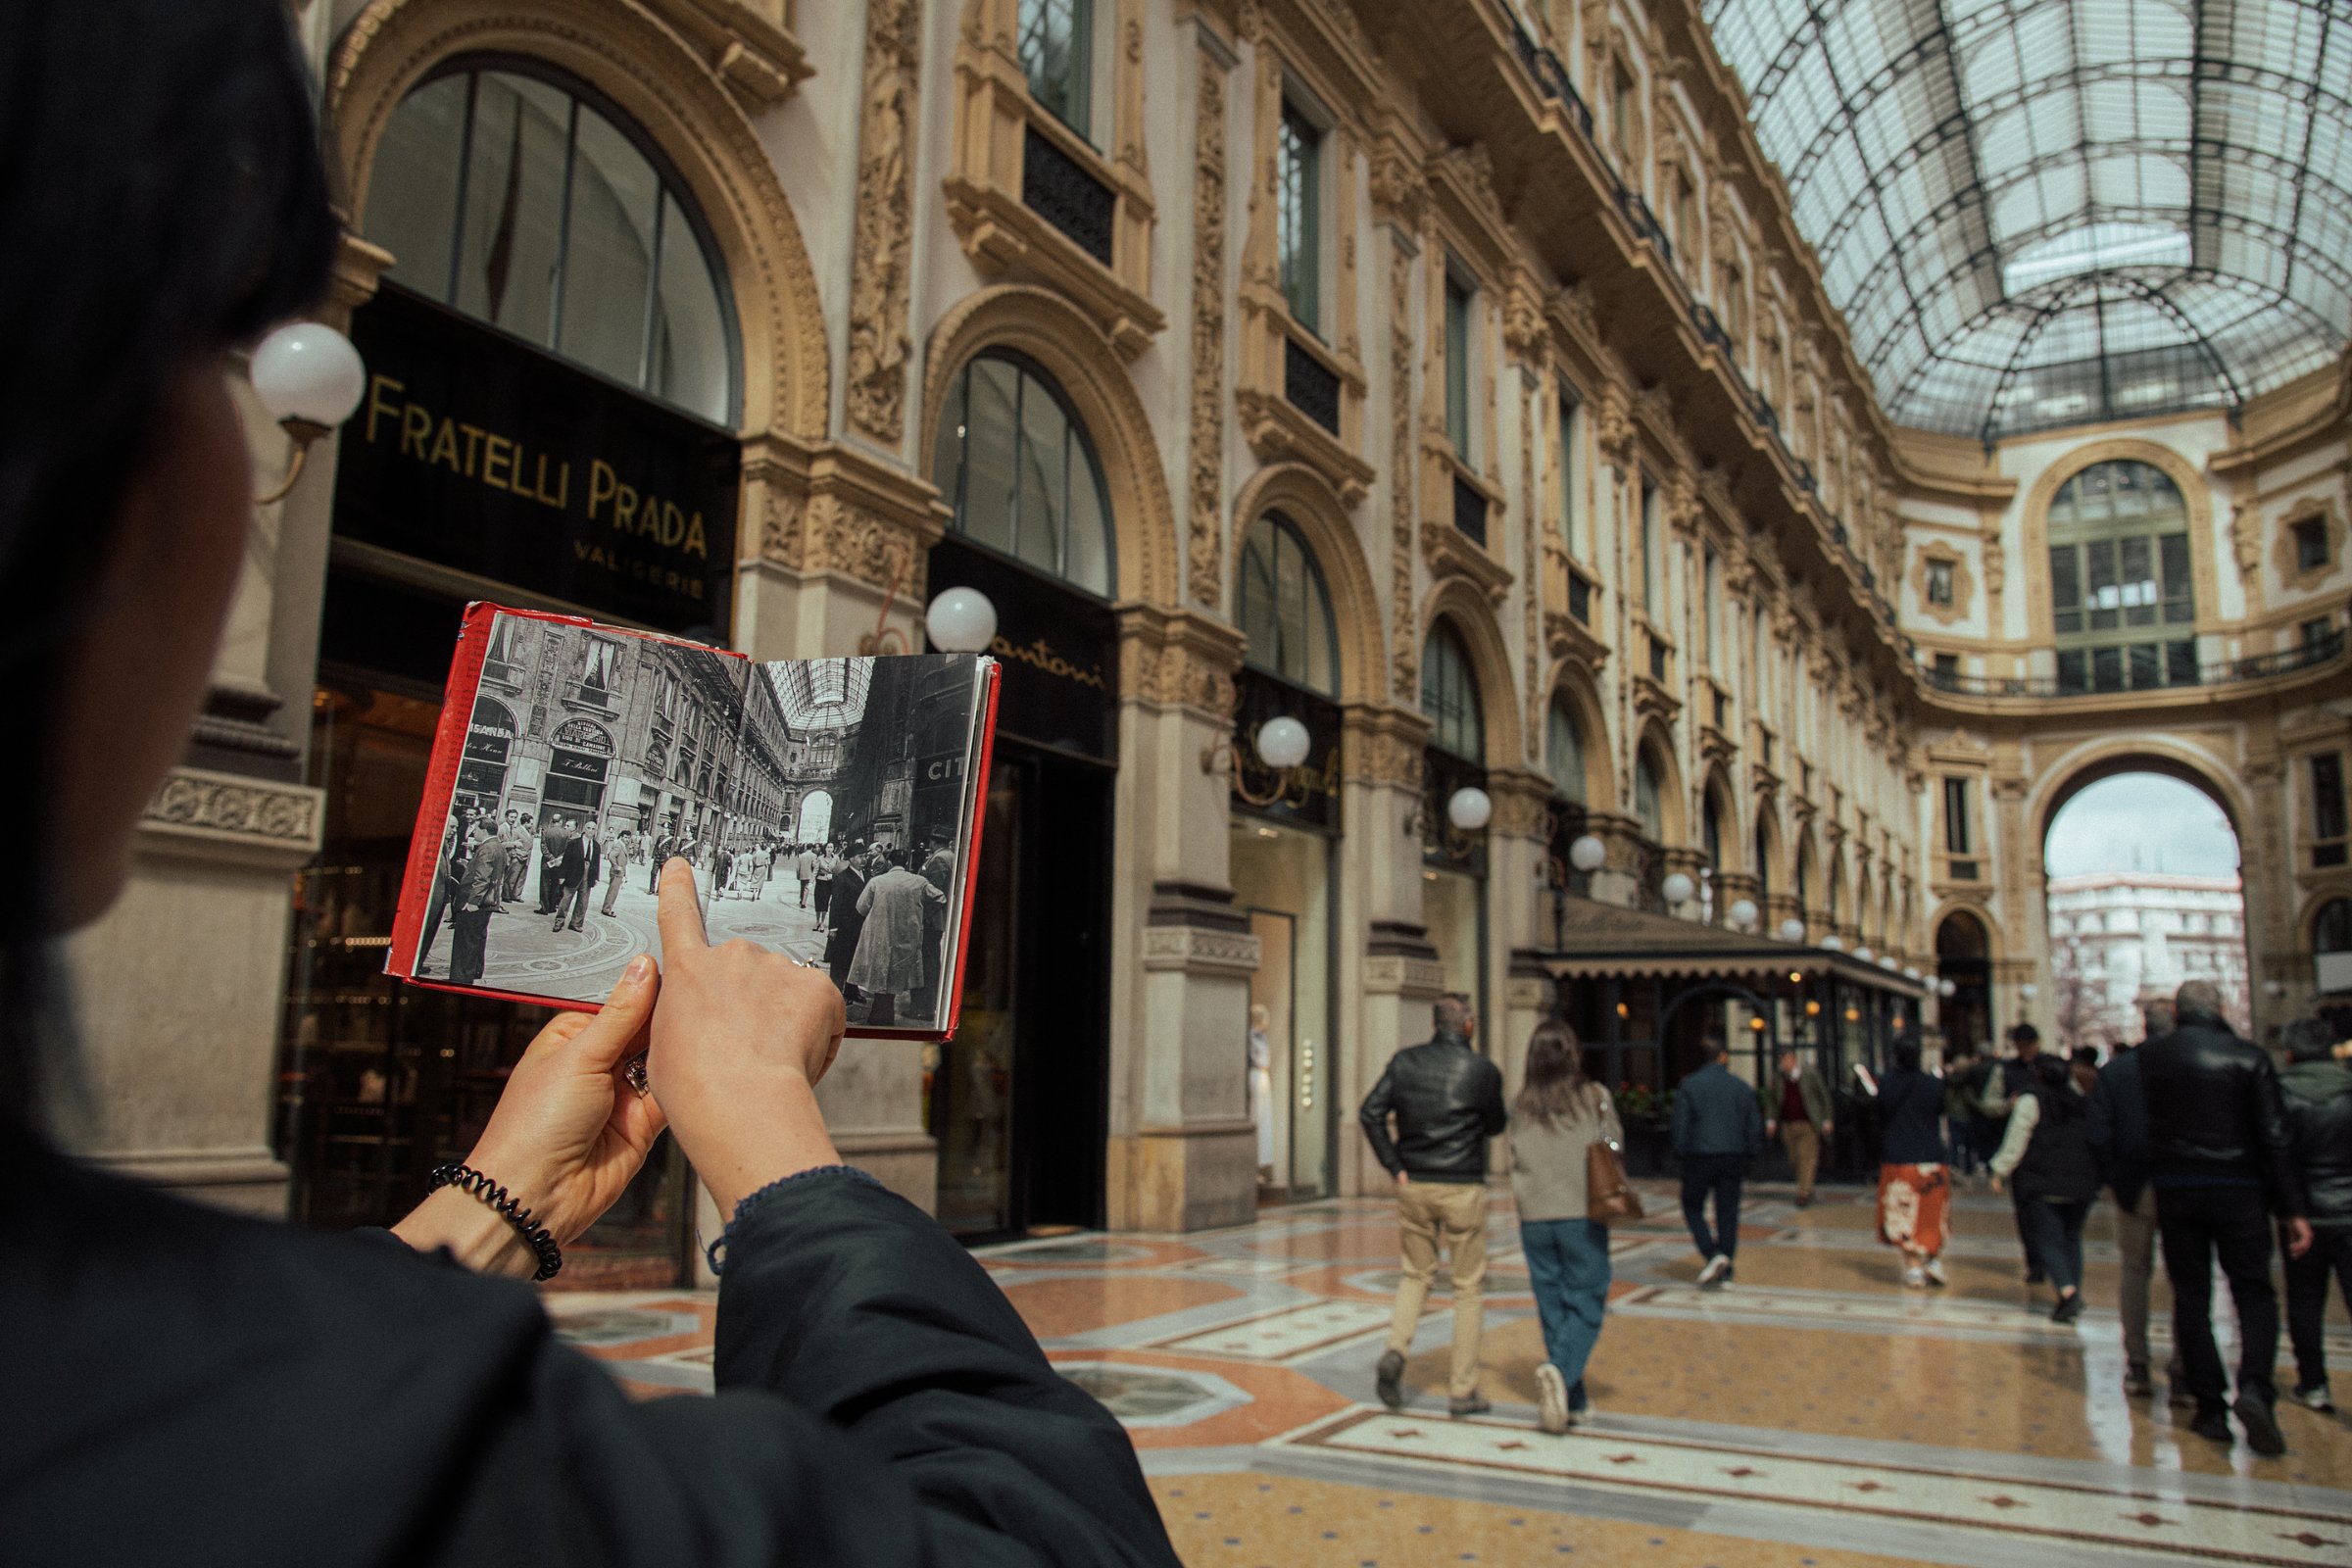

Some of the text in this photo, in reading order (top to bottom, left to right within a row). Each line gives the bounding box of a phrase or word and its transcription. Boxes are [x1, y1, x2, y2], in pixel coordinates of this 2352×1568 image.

[367, 373, 707, 559] FRATELLI PRADA
[992, 635, 1105, 688] antoni
